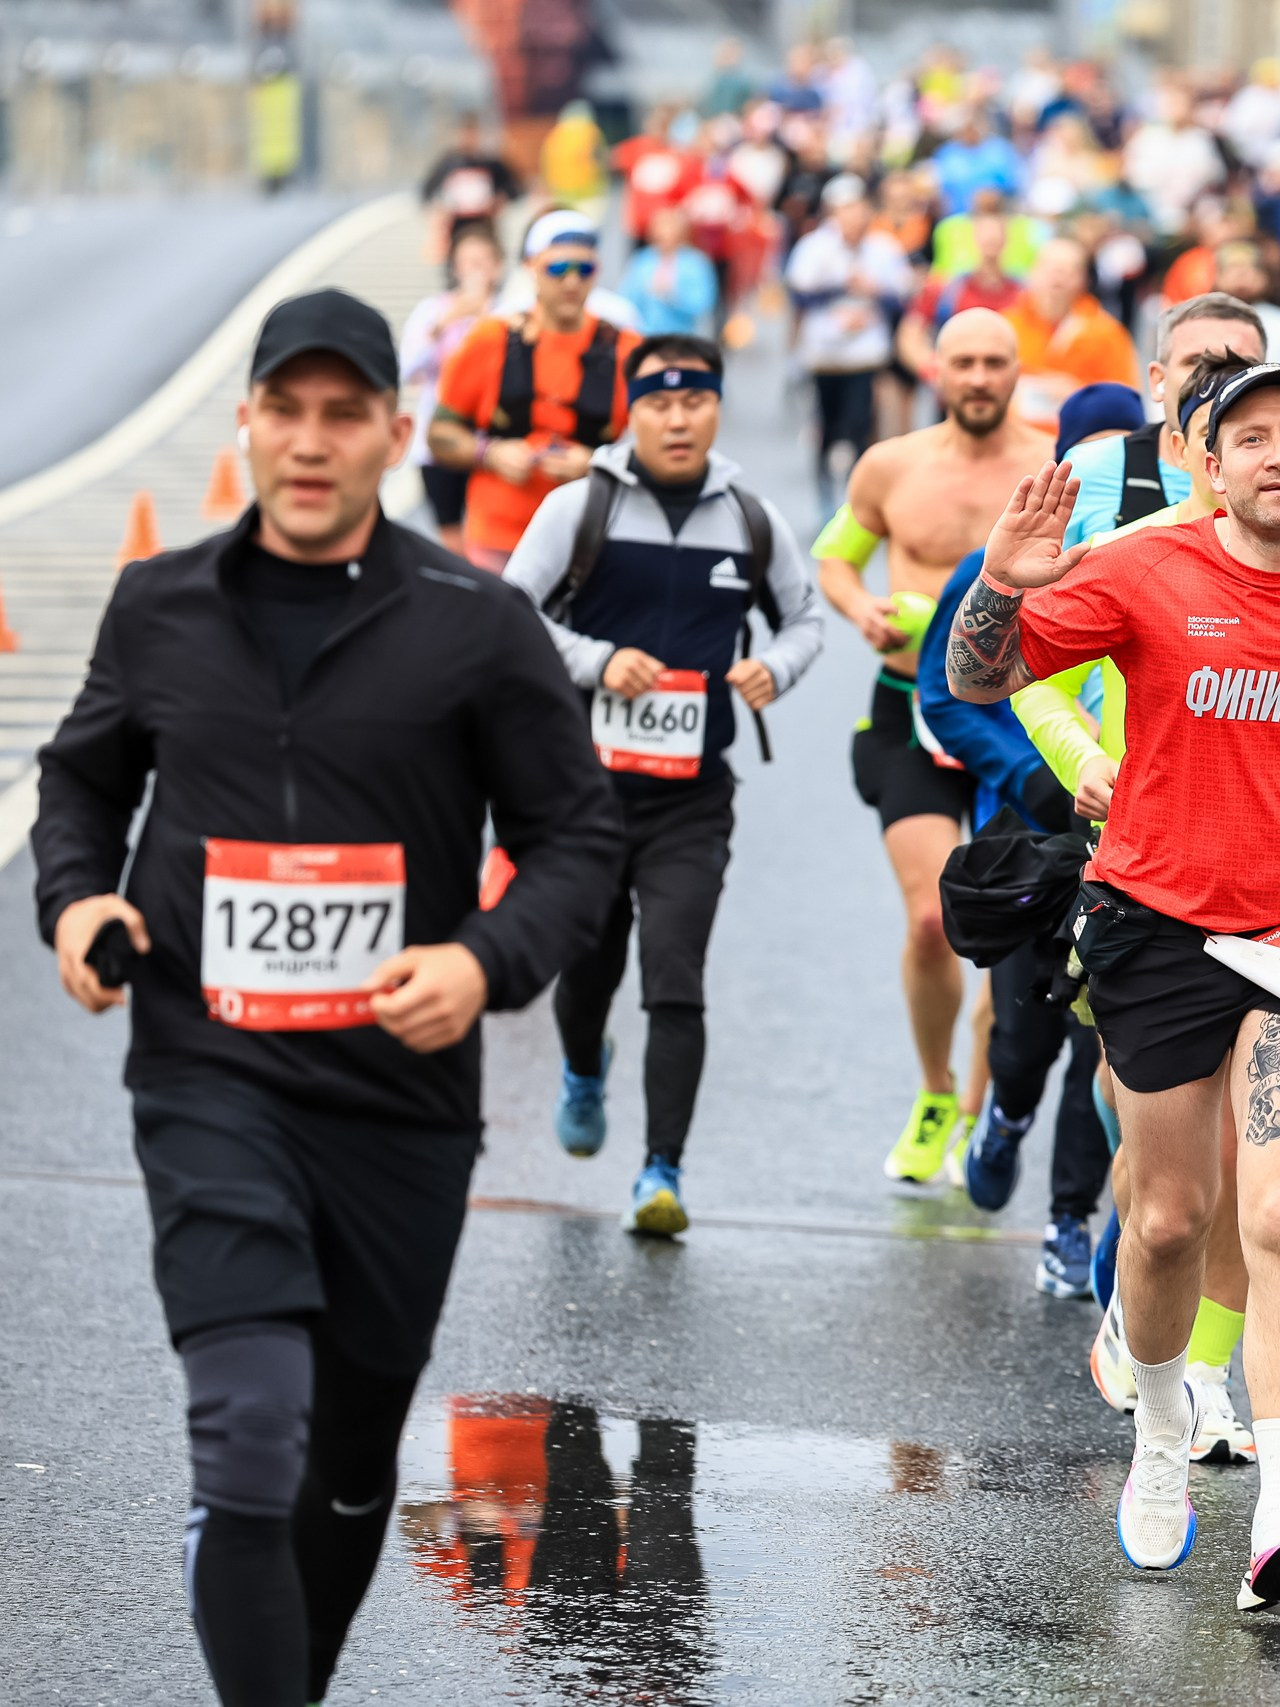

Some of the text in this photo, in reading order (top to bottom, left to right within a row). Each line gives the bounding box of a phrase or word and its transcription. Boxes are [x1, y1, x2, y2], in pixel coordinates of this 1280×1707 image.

[1187, 616, 1240, 625] МОСКОВСКИЙ
[1187, 630, 1226, 638] МАРАФОН
[602, 695, 699, 733] 11660
[217, 897, 391, 954] 12877
